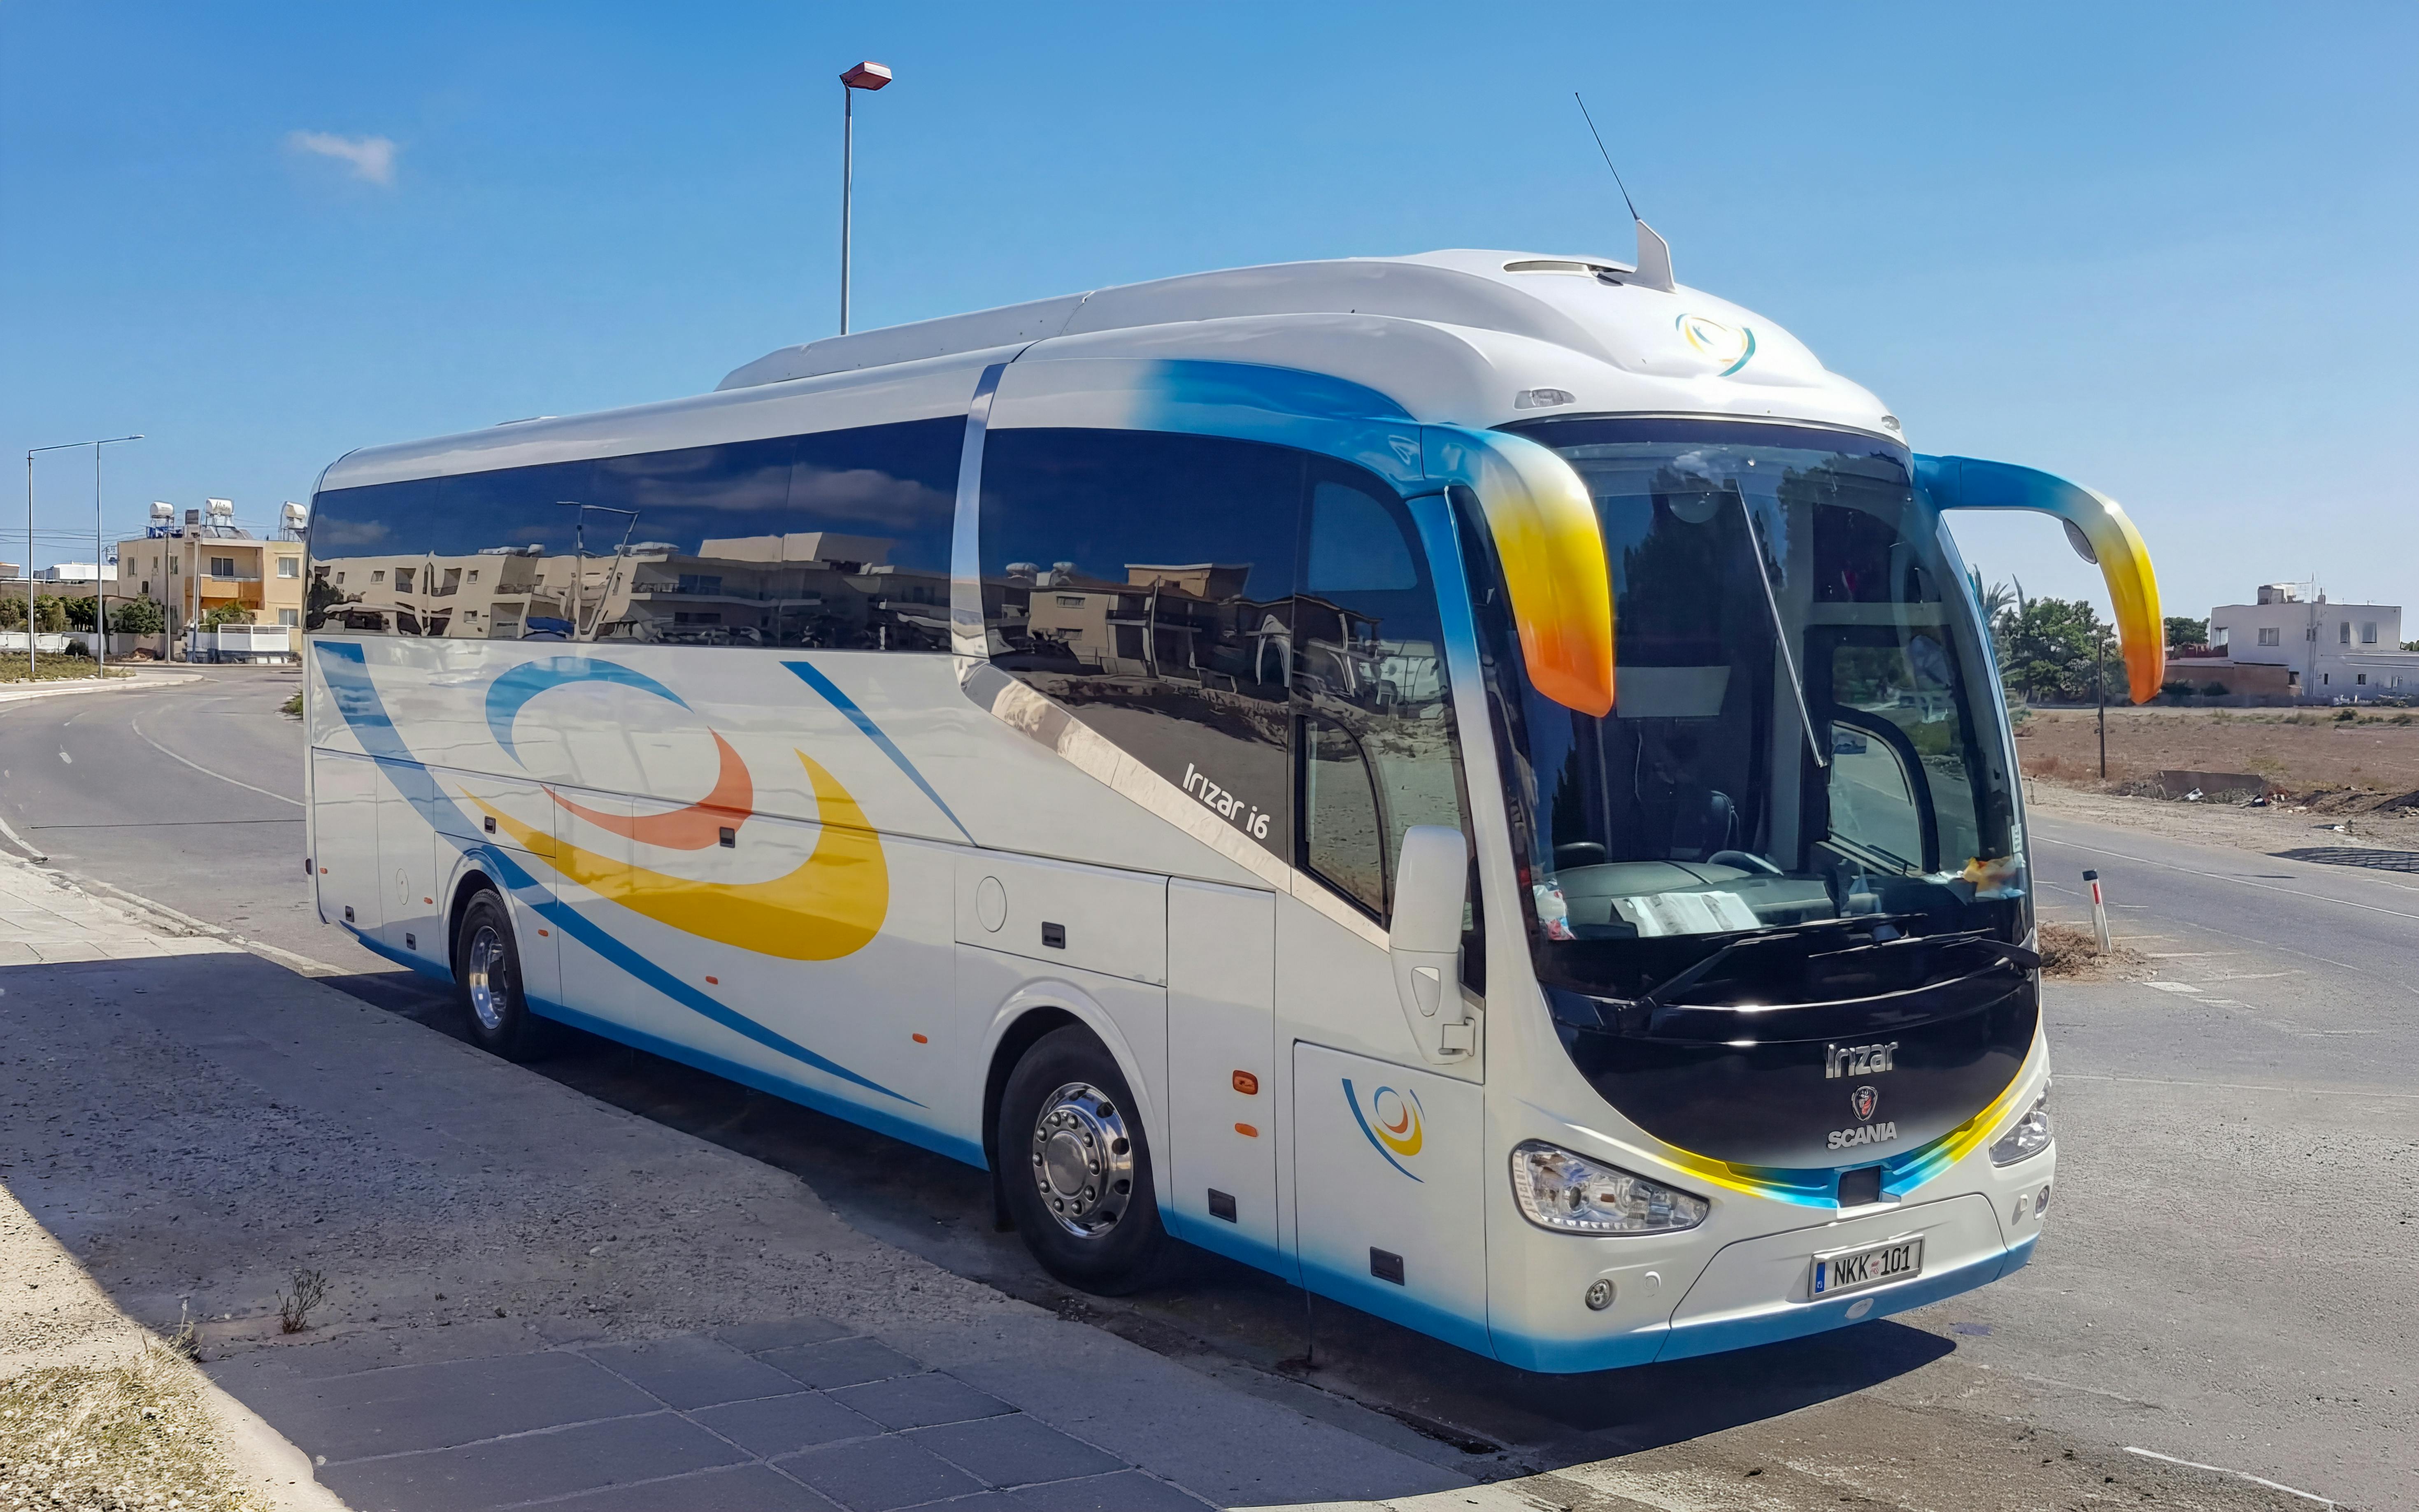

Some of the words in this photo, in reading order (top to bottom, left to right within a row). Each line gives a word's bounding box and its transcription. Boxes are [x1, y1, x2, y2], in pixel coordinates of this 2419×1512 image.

[1182, 763, 1245, 821] Irizar
[1246, 805, 1270, 840] i6
[1825, 1042, 1898, 1079] Irizar
[1827, 1122, 1898, 1150] SCANIA
[1834, 1254, 1870, 1286] NKK
[1881, 1245, 1910, 1275] 101
